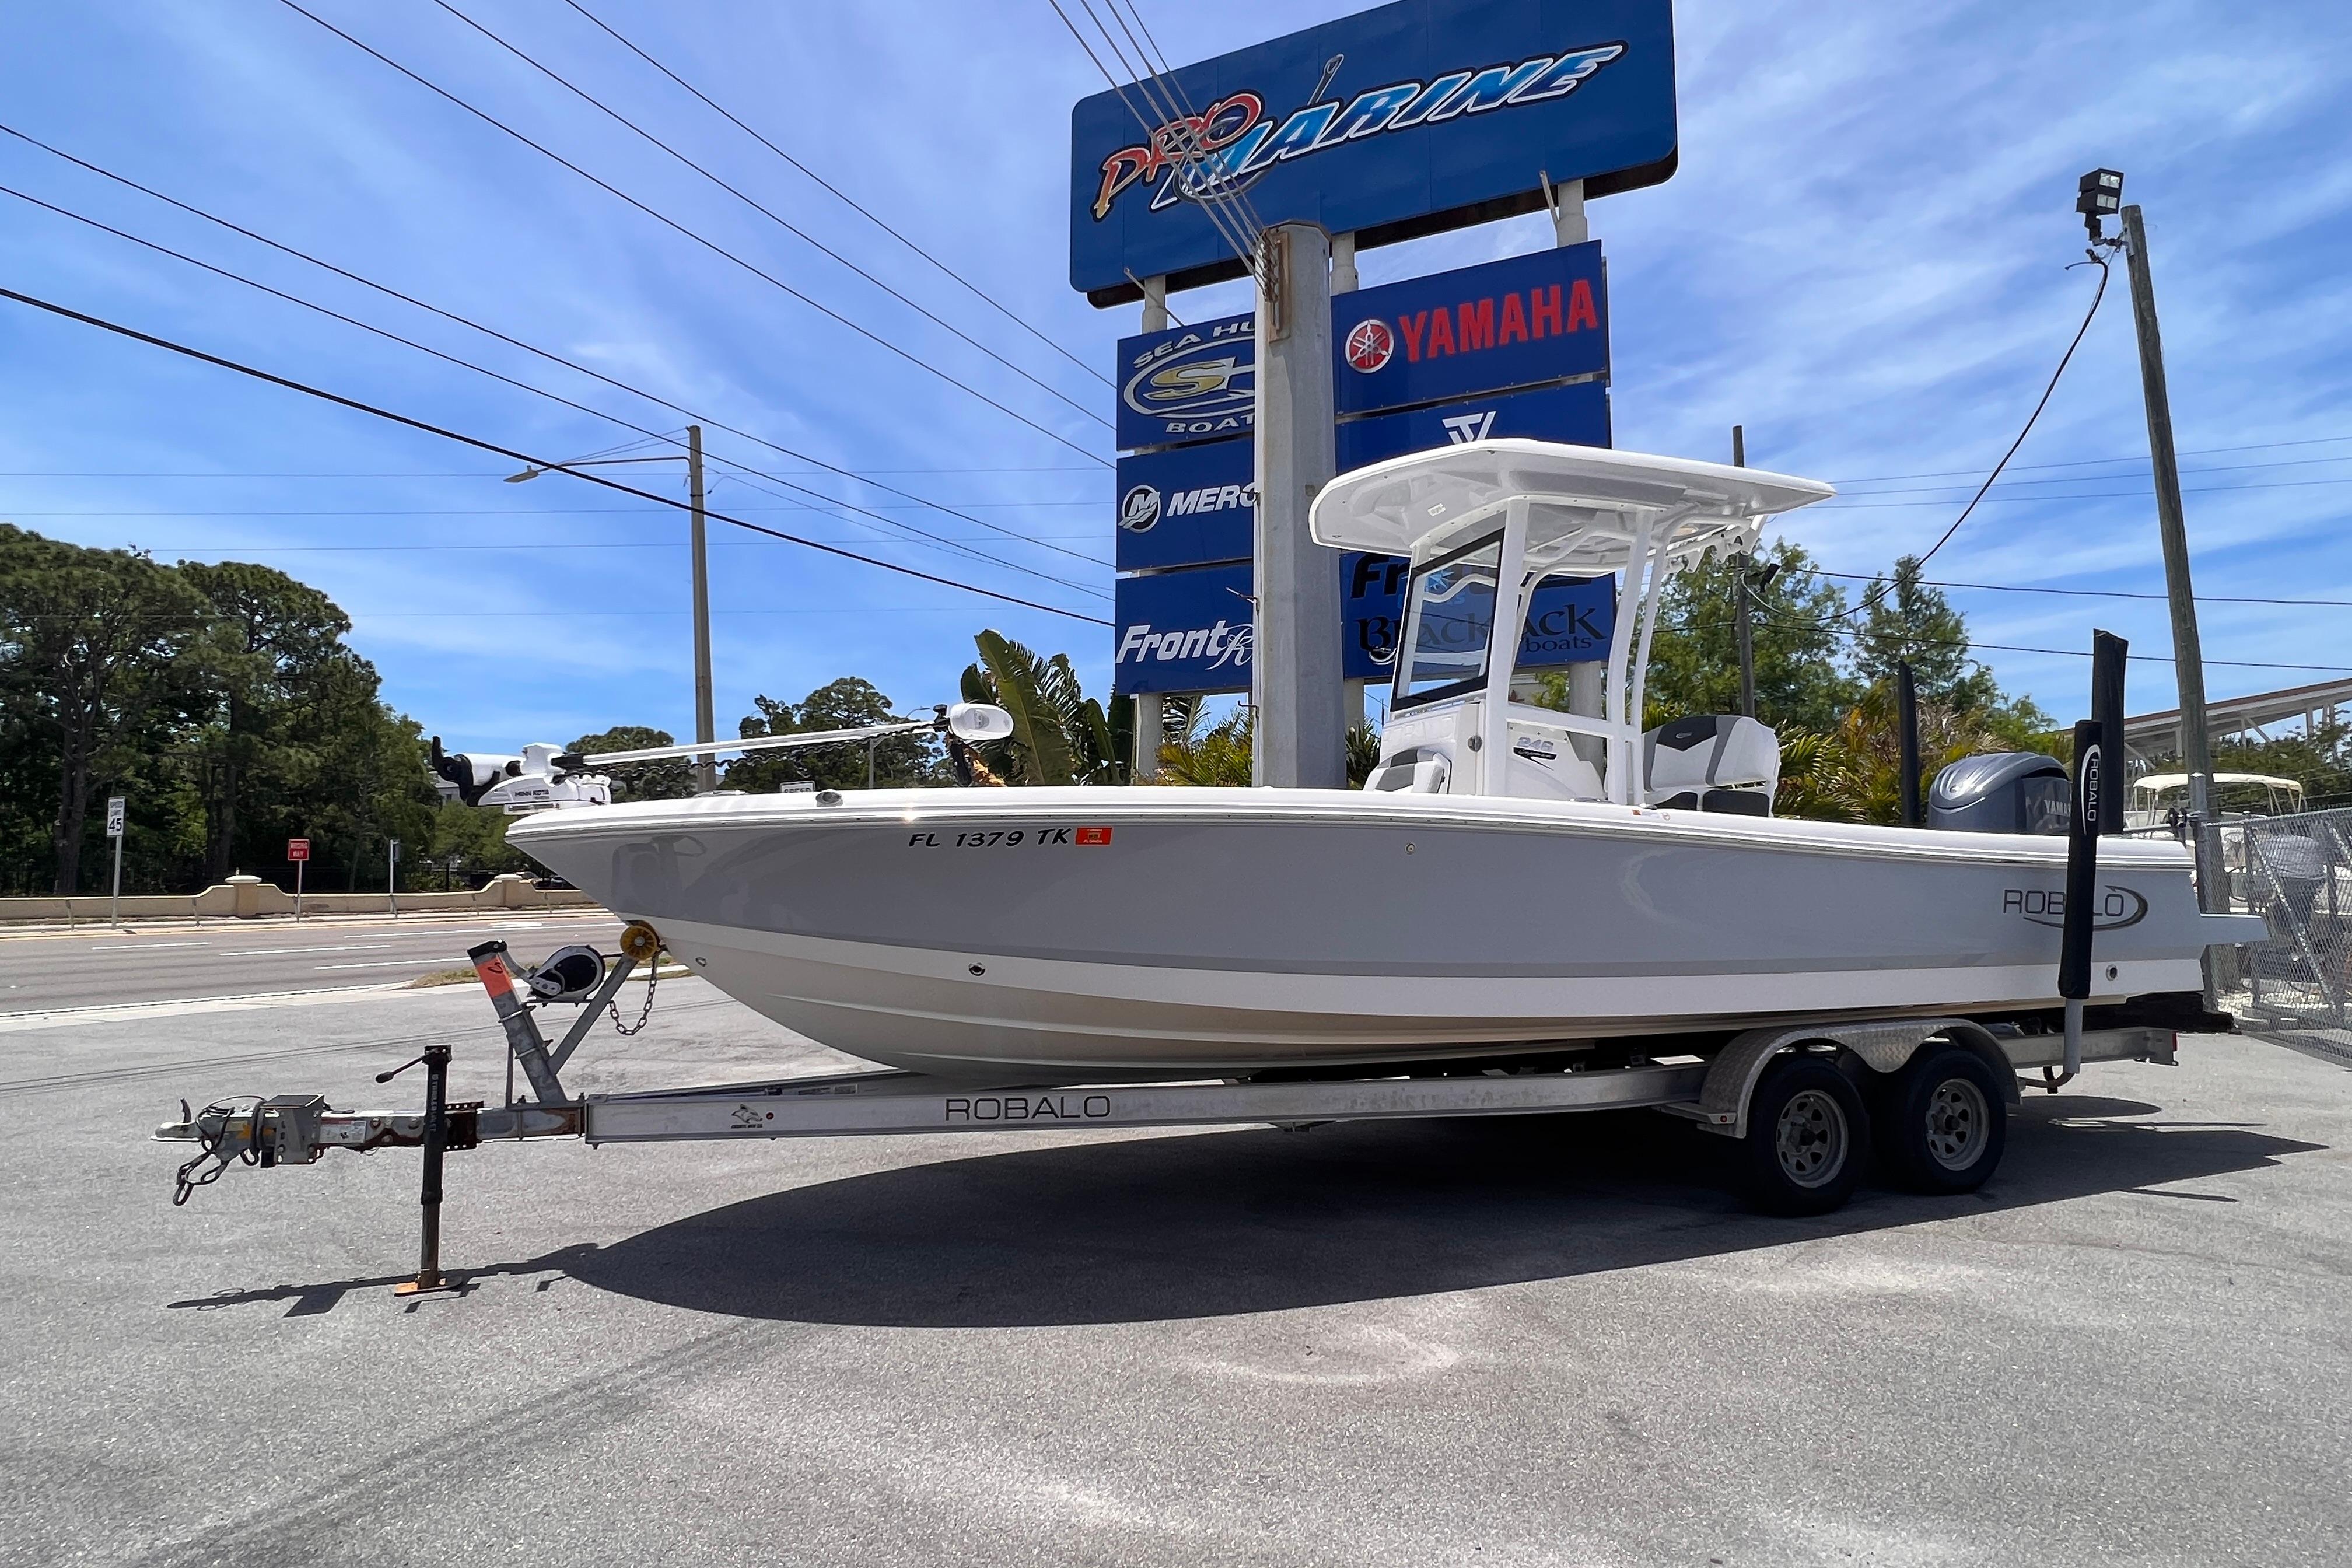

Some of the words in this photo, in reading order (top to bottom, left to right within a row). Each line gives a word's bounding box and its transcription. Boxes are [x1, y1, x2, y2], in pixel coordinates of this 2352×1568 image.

[1150, 44, 1623, 210] MARINE
[1092, 92, 1262, 219] PRO
[1399, 279, 1598, 363] YAMAHA
[1133, 333, 1201, 369] SEA
[1212, 321, 1255, 337] HU
[1166, 413, 1255, 433] BOAT
[1166, 481, 1256, 517] MERC
[1115, 620, 1254, 671] FrontR
[1524, 635, 1592, 653] boats
[1517, 736, 1554, 751] 246
[2087, 758, 2099, 822] ROBALO
[2043, 799, 2071, 818] YAMA
[108, 818, 122, 832] 45
[908, 832, 941, 847] FL
[956, 831, 1025, 847] 1379
[1037, 828, 1072, 845] TK
[2003, 889, 2124, 917] ROBO
[945, 1096, 1111, 1121] ROBALO
